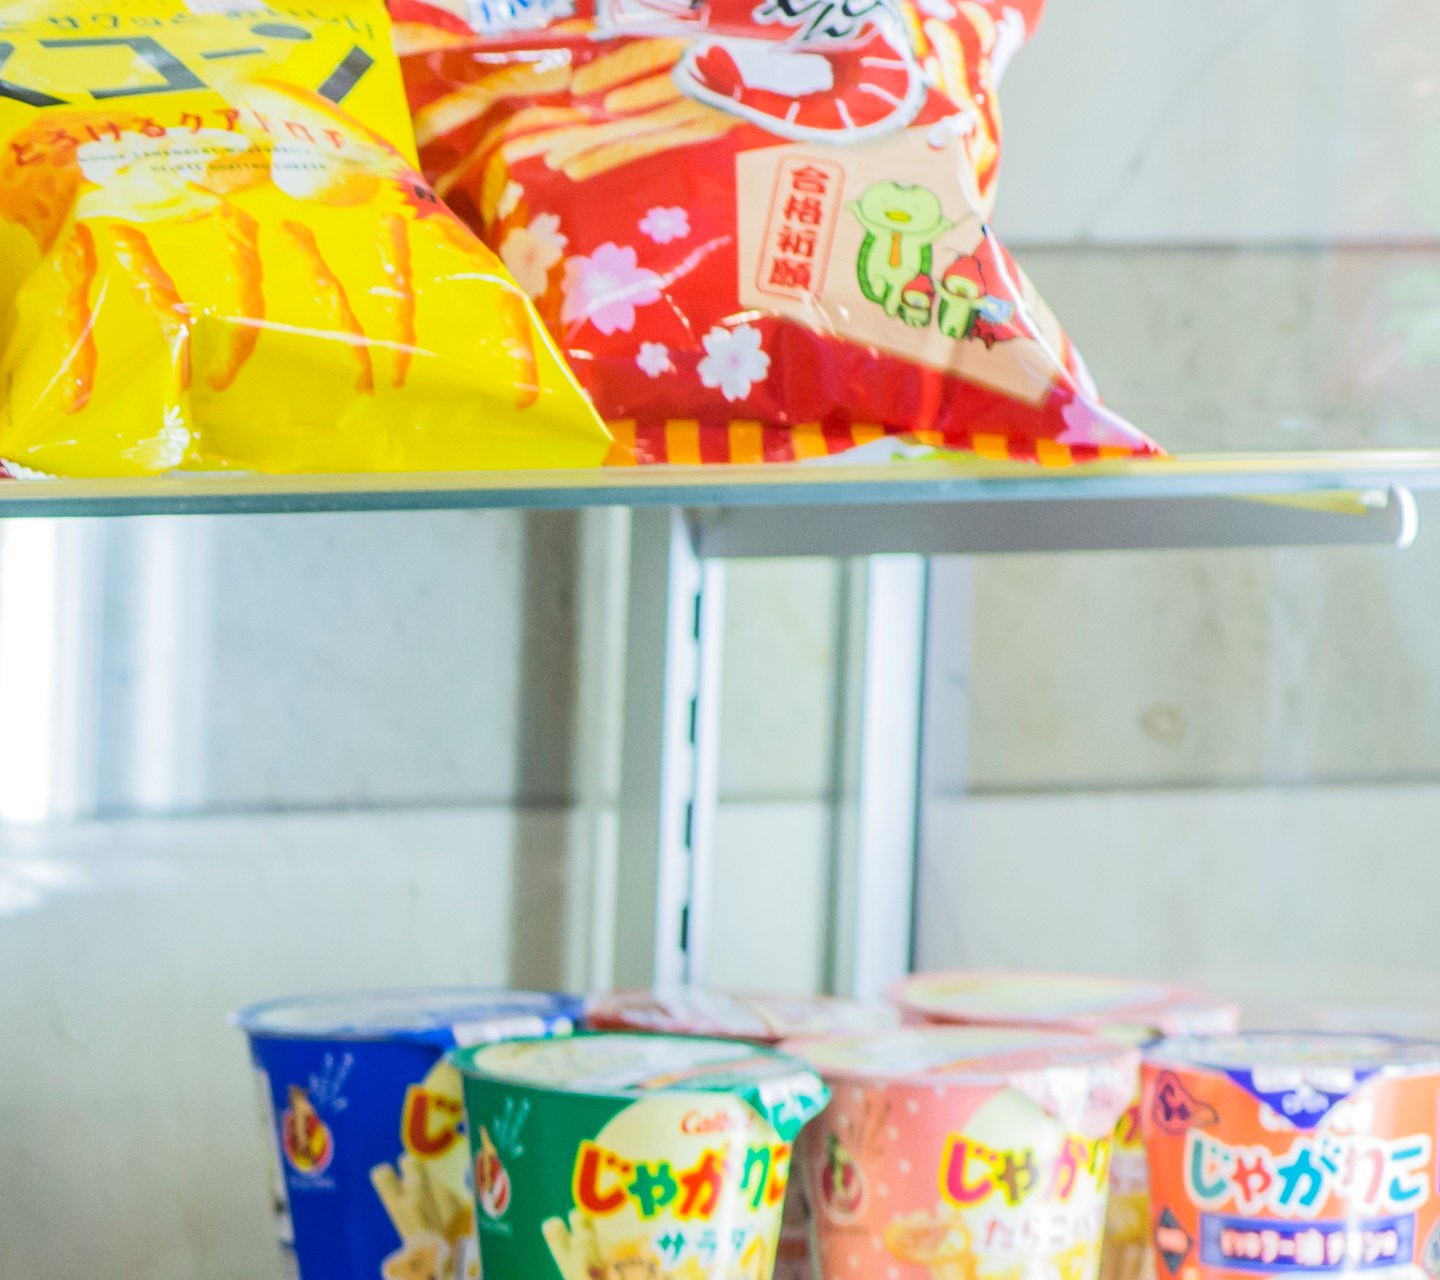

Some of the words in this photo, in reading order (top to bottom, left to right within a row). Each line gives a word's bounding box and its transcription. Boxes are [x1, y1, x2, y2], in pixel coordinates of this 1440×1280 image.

[1190, 1136, 1424, 1208] じゃがりこ
